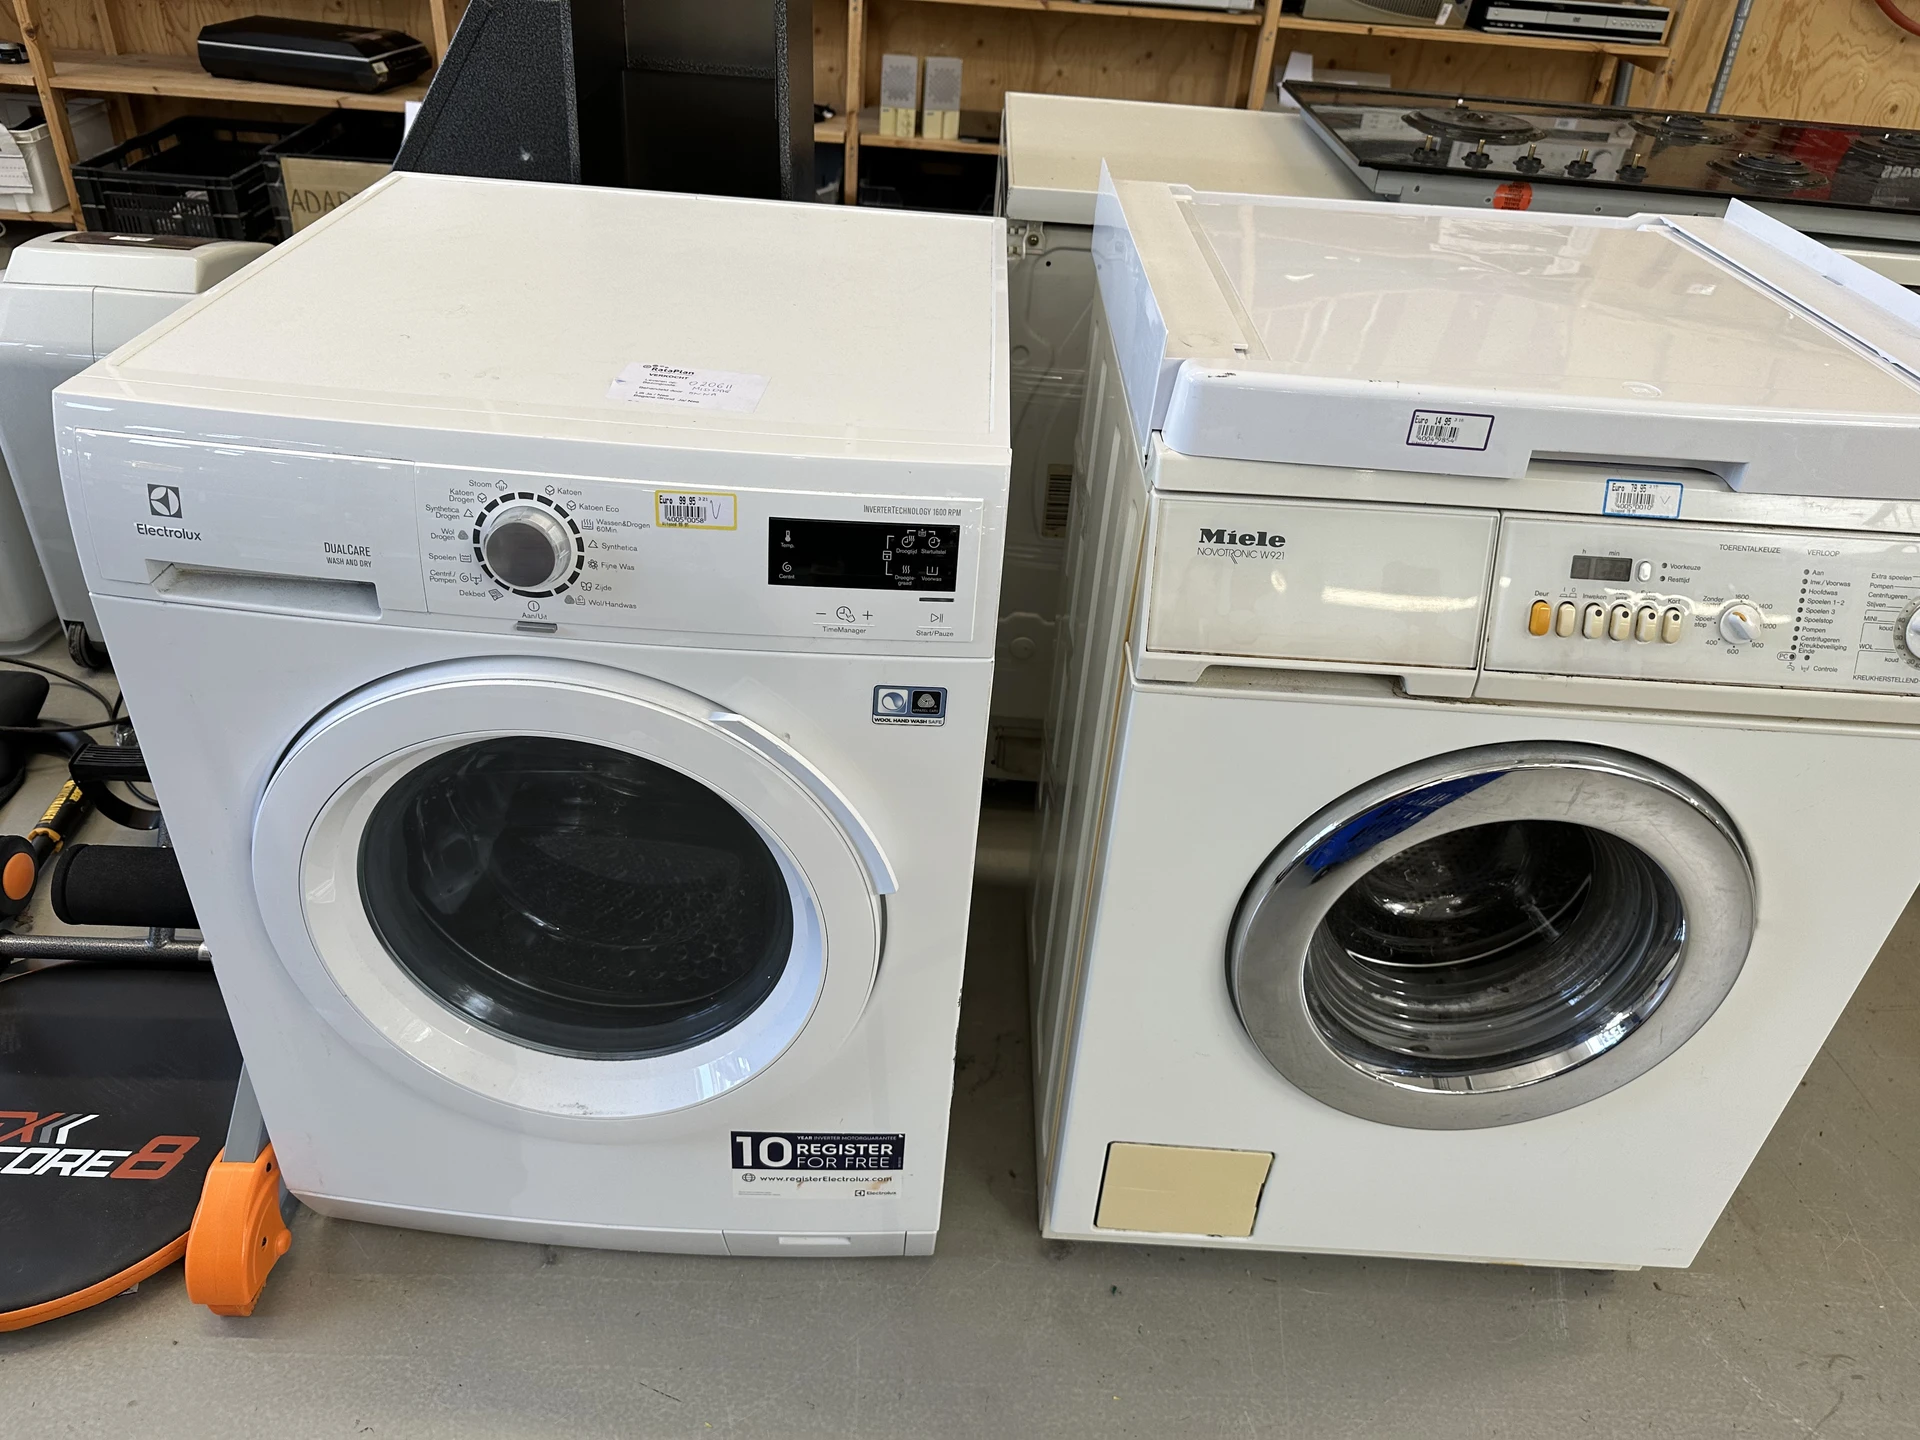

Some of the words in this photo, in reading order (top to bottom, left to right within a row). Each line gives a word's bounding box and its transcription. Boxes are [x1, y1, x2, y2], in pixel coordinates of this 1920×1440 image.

[1415, 415, 1428, 424] Euro
[450, 488, 474, 496] Katoen
[557, 487, 582, 496] Katoen
[1612, 483, 1625, 492] Euro
[449, 495, 474, 504] Drogen
[659, 495, 673, 504] Euro
[426, 504, 459, 513] Synthetica
[579, 503, 603, 511] Katoen
[606, 505, 620, 513] Eco
[933, 508, 946, 516] 1600
[436, 512, 460, 521] Drogen
[596, 518, 650, 529] Wassen&Drogen
[136, 523, 202, 541] Electrolux
[431, 532, 455, 541] Drogen
[1198, 528, 1286, 548] Miele
[324, 542, 371, 557] DUALCARE
[601, 542, 638, 554] Synthetica
[1719, 544, 1781, 554] TOERENTALKEUZE
[429, 552, 457, 561] Spoelen
[1197, 547, 1257, 562] NOVOTRONIC
[326, 557, 344, 565] WASH
[346, 559, 358, 567] AND
[360, 560, 372, 568] DRY
[601, 562, 617, 570] Fijne
[430, 576, 457, 584] Pompen
[595, 584, 612, 592] Zijde
[1868, 592, 1908, 600] Centrifugeren
[588, 599, 637, 609] Wol/Handwas
[1804, 616, 1834, 624] Spoelstop
[822, 626, 866, 635] TimeManager
[1800, 635, 1840, 643] Centrifugeren
[736, 1136, 793, 1168] 10
[797, 1144, 893, 1155] REGISTER
[797, 1157, 837, 1168] FOR
[845, 1157, 890, 1168] FREE
